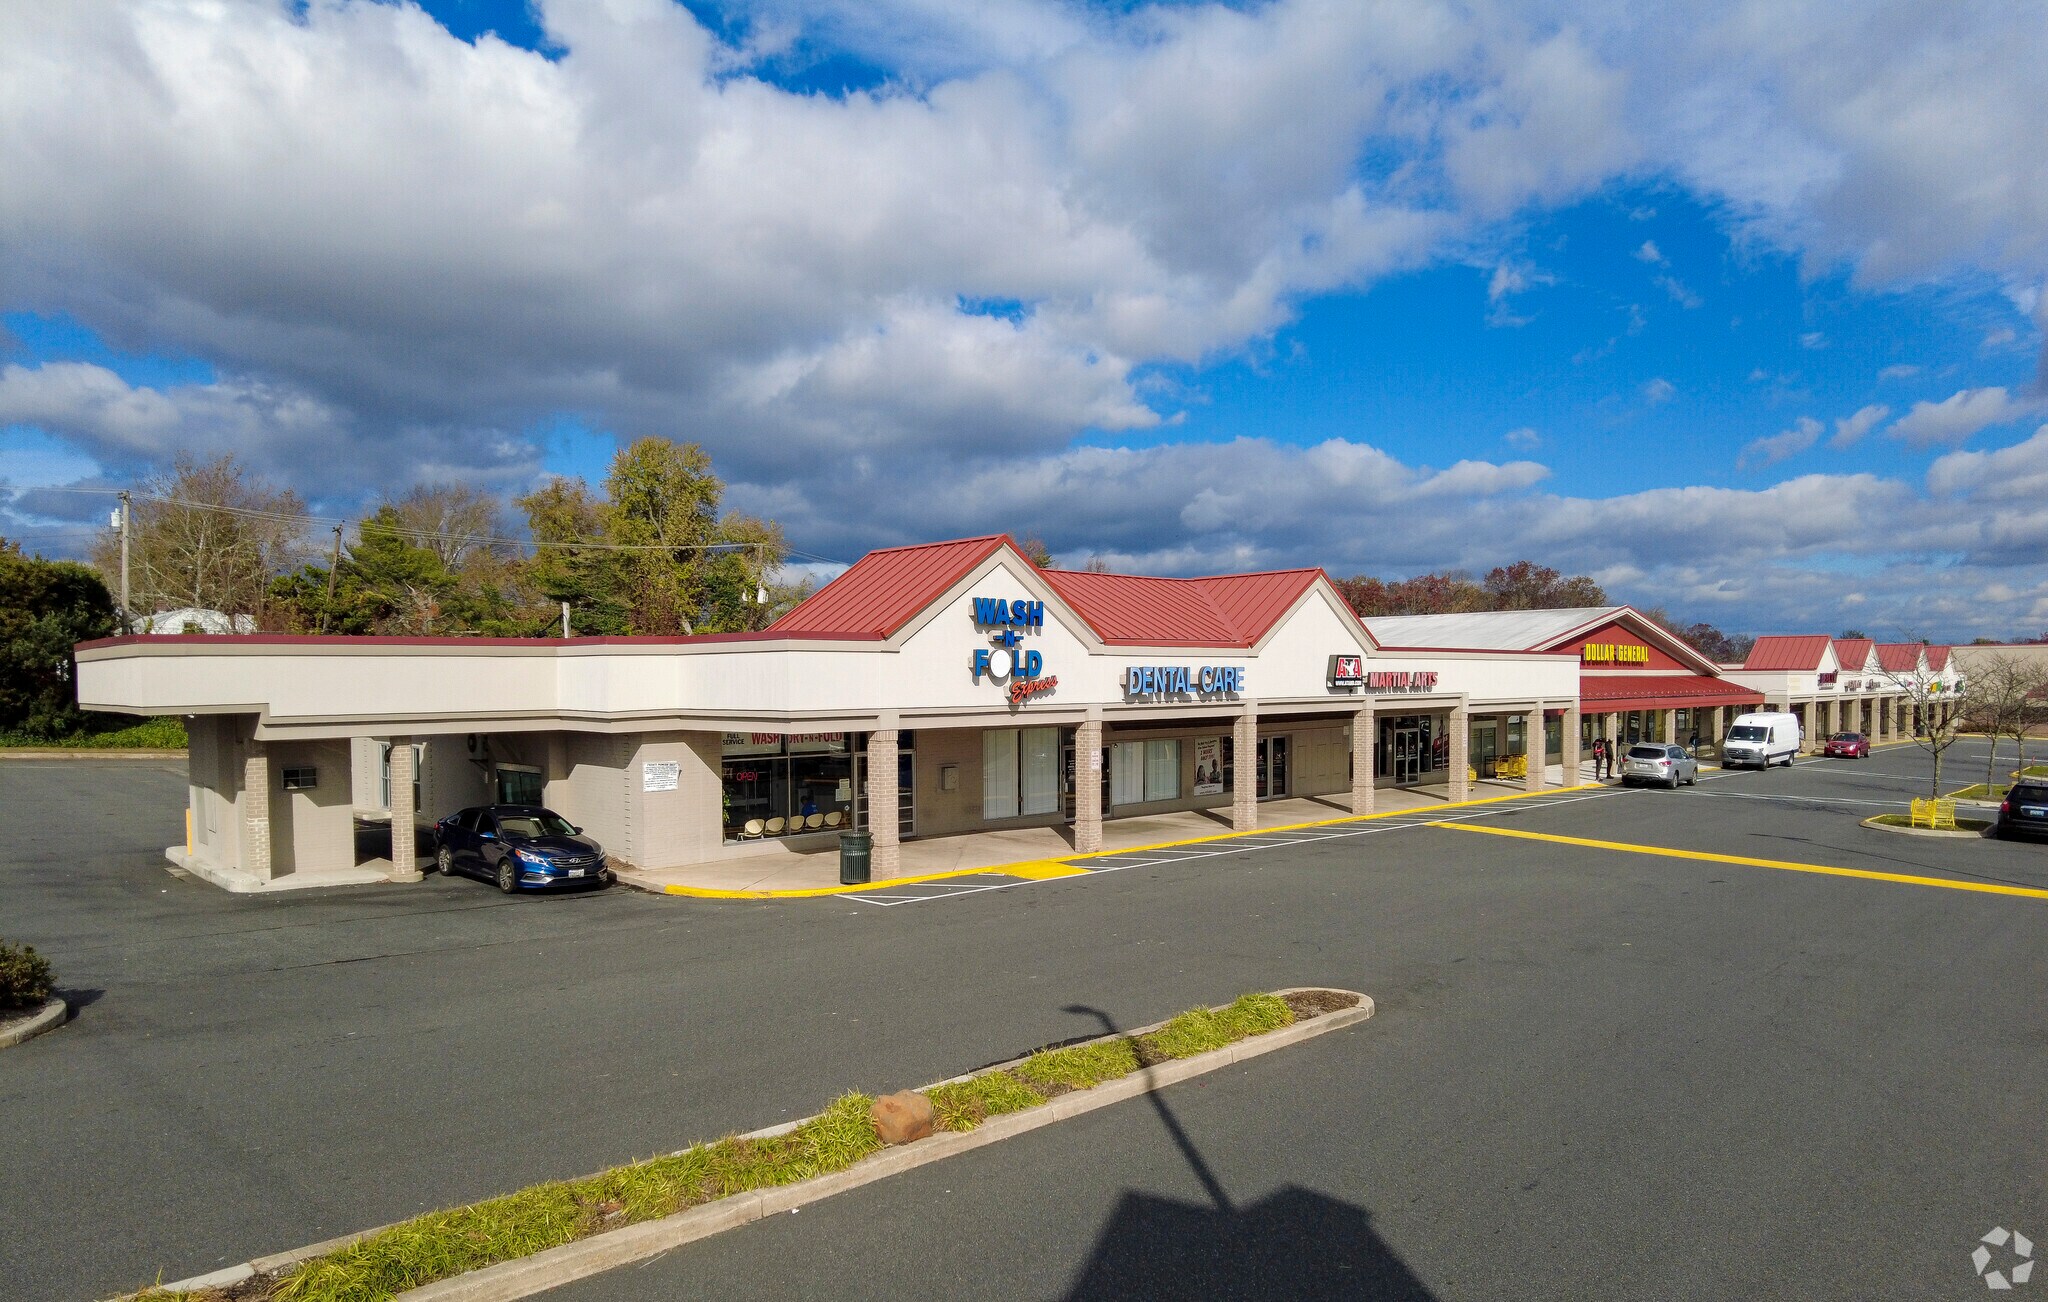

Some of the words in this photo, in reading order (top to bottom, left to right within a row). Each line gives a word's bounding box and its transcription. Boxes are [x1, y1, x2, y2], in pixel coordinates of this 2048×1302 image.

[973, 597, 1043, 627] WASH
[973, 649, 1043, 678] FOLD
[1585, 643, 1615, 661] DOLLAR
[1618, 645, 1649, 662] GENERAL
[1011, 674, 1058, 703] Express
[1128, 666, 1197, 694] DENTAL
[1200, 666, 1245, 693] CARE
[1368, 672, 1412, 688] MARTIAL
[1414, 672, 1438, 688] ARTS
[751, 732, 780, 745] WASH
[736, 771, 758, 781] OPEN
